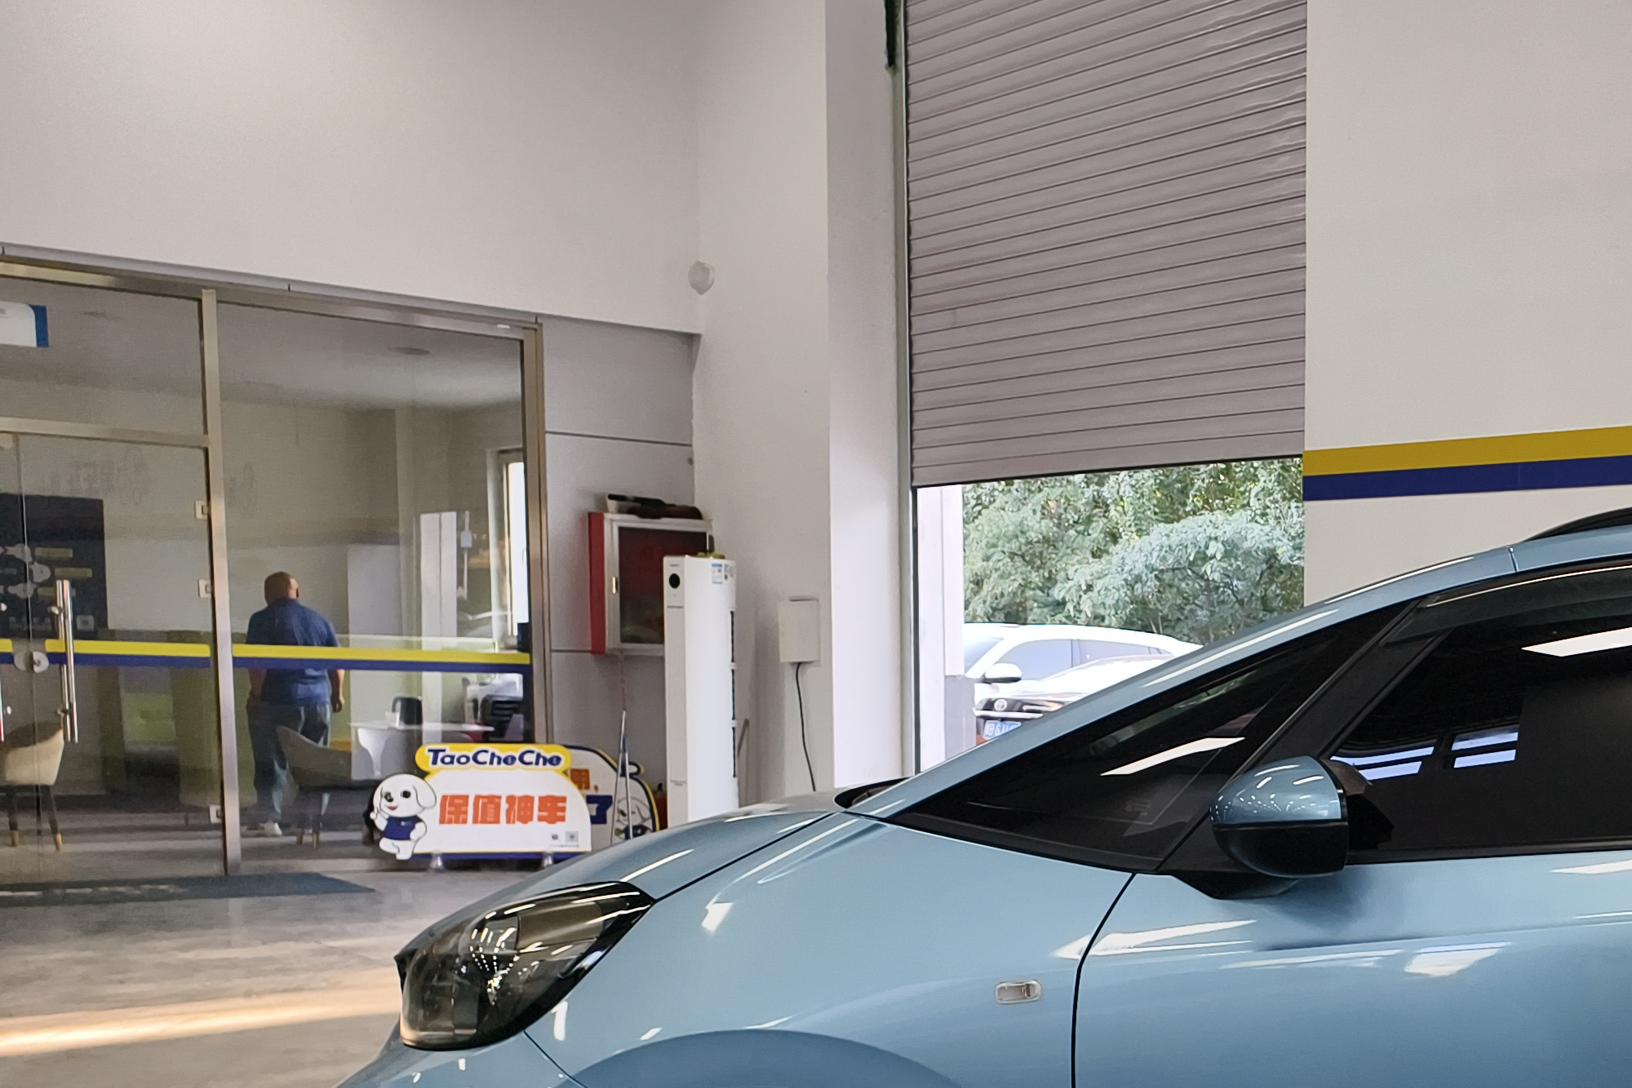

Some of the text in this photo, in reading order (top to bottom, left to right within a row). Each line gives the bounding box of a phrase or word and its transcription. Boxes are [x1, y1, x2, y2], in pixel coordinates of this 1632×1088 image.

[427, 748, 563, 767] TaoCheChe
[439, 794, 567, 825] 保值神车
